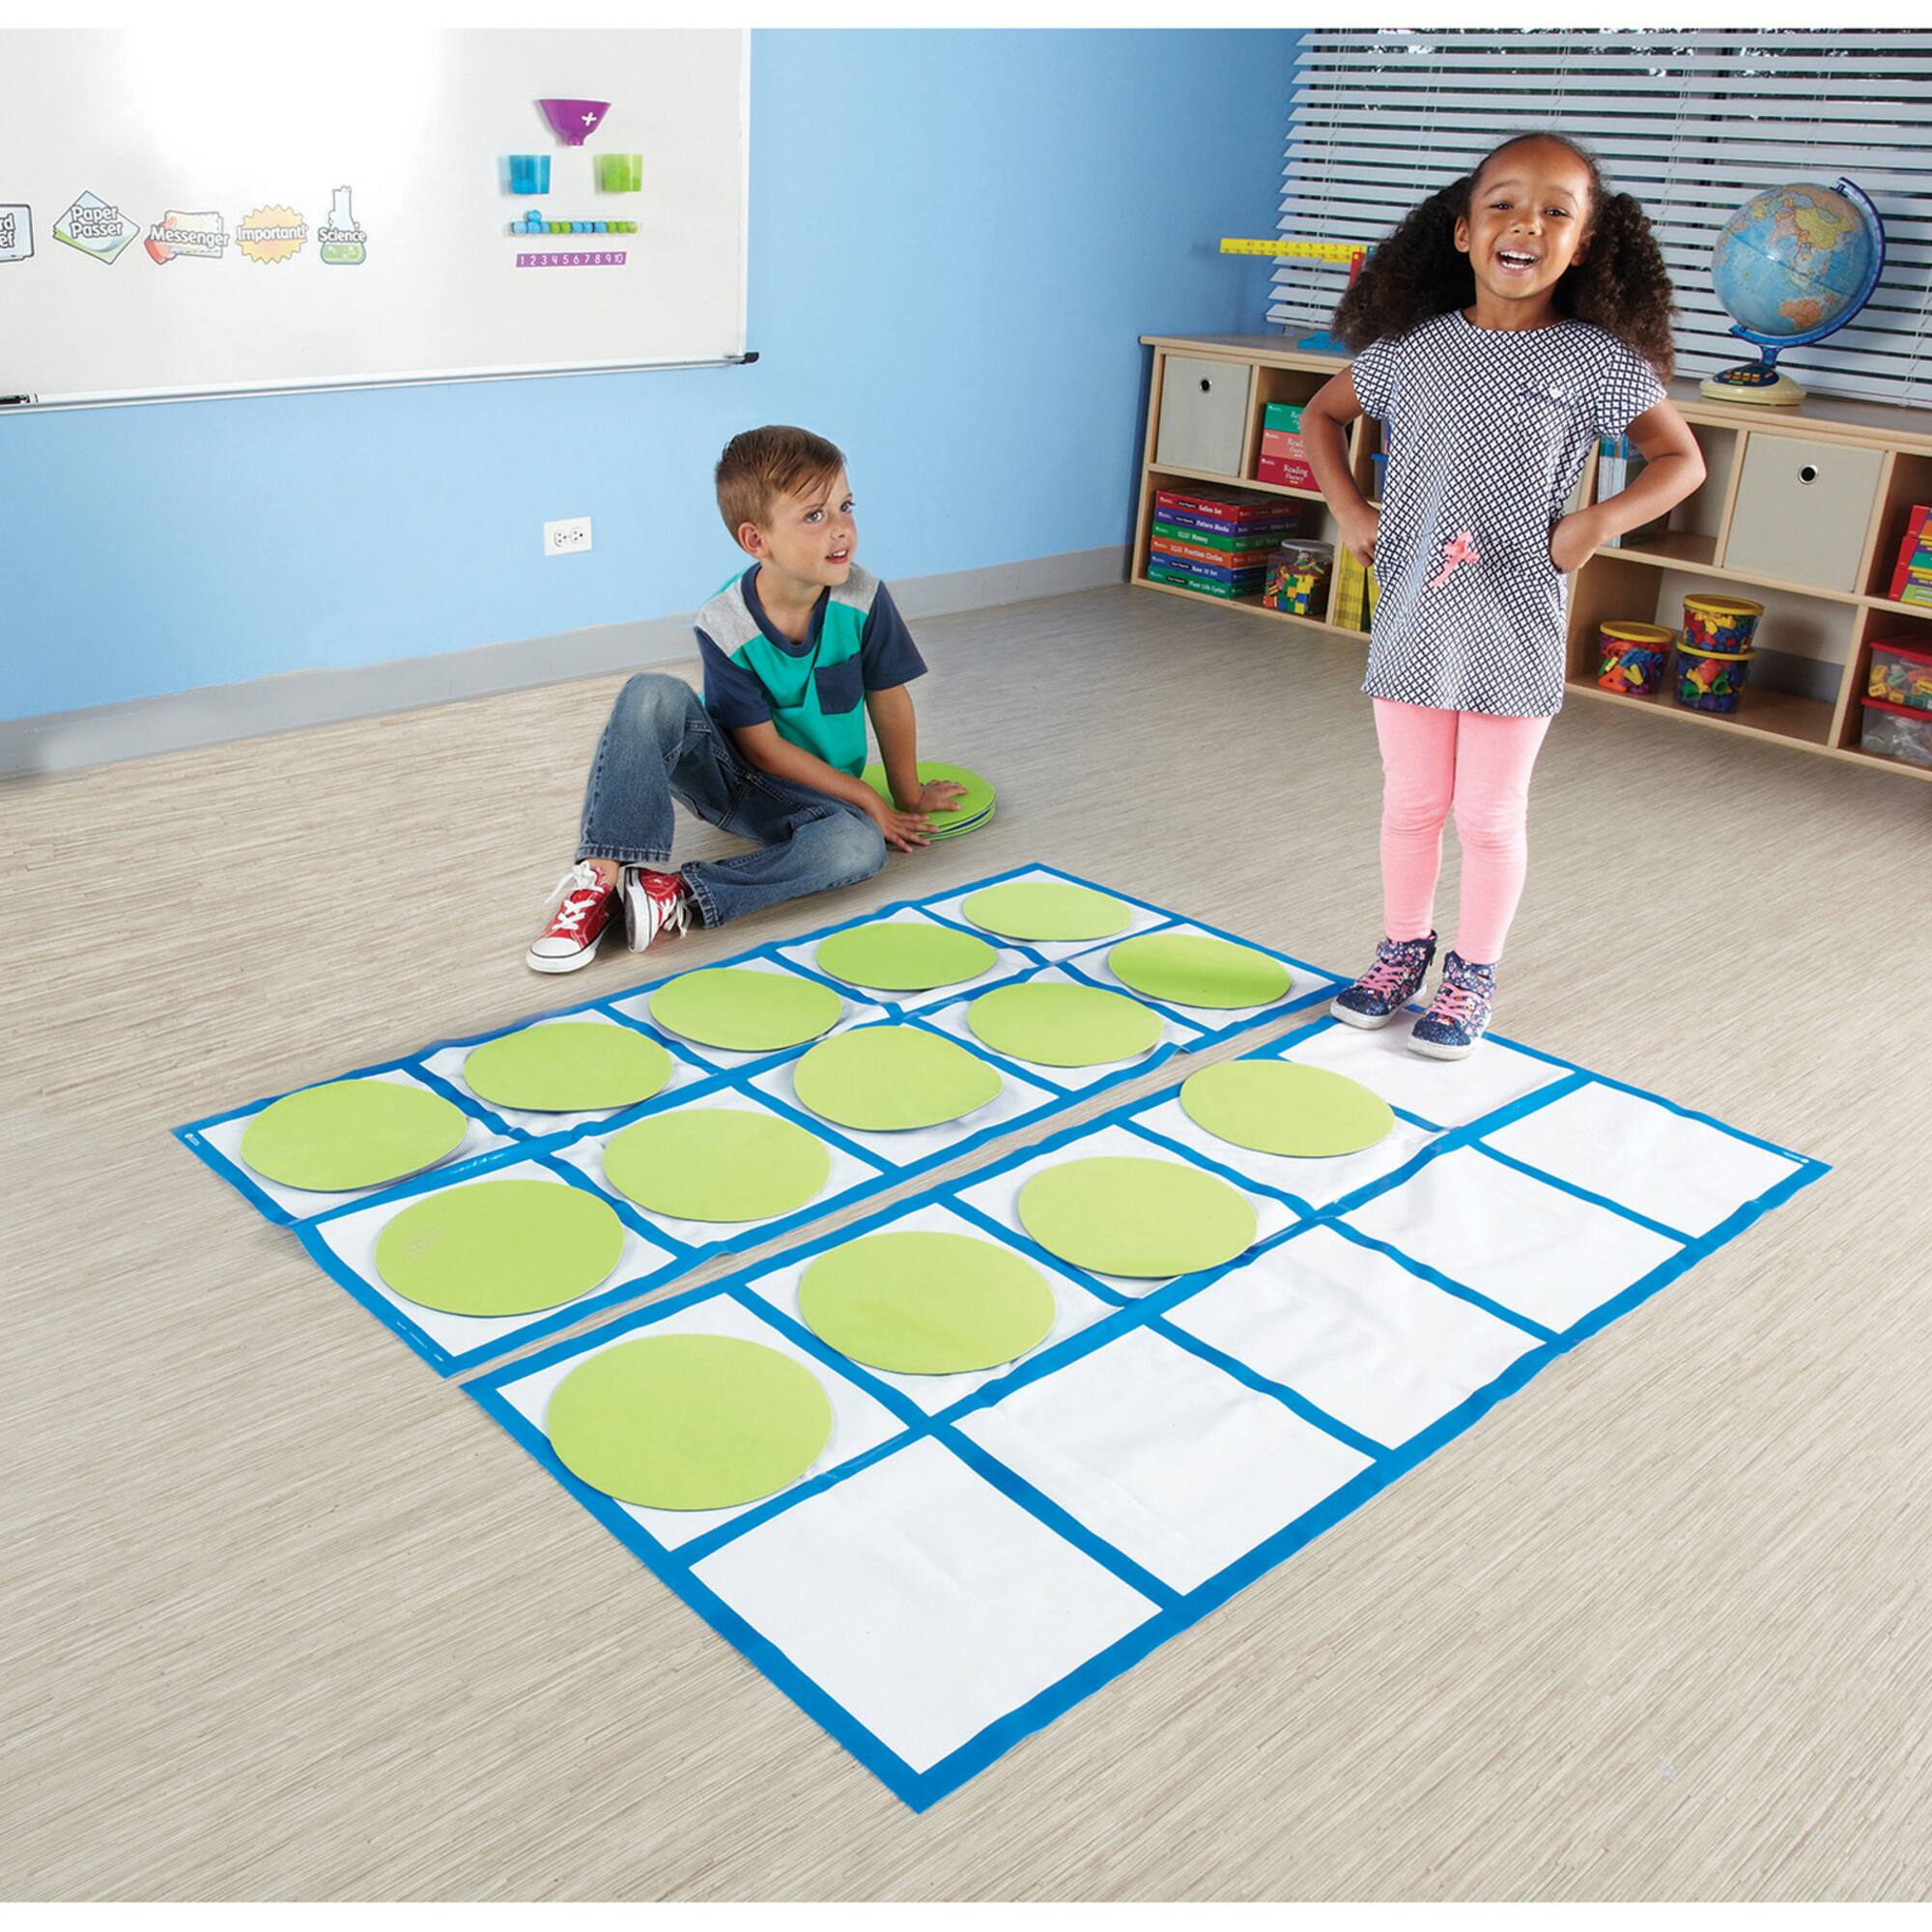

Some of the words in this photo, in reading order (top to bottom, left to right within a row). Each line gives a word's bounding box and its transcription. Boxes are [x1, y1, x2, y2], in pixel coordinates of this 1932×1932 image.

[71, 205, 118, 223] Paper
[71, 221, 124, 239] Passer
[150, 225, 230, 247] Messenger
[318, 227, 368, 242] Science
[520, 256, 525, 265] 1
[530, 255, 536, 265] 2
[541, 255, 548, 265] 3
[552, 255, 558, 264] 4
[562, 255, 569, 264] 5
[573, 255, 580, 264] 6
[583, 254, 590, 264] 7
[594, 254, 601, 264] 8
[605, 254, 611, 263] 9
[614, 253, 624, 264] 10
[1283, 464, 1309, 477] Reading
